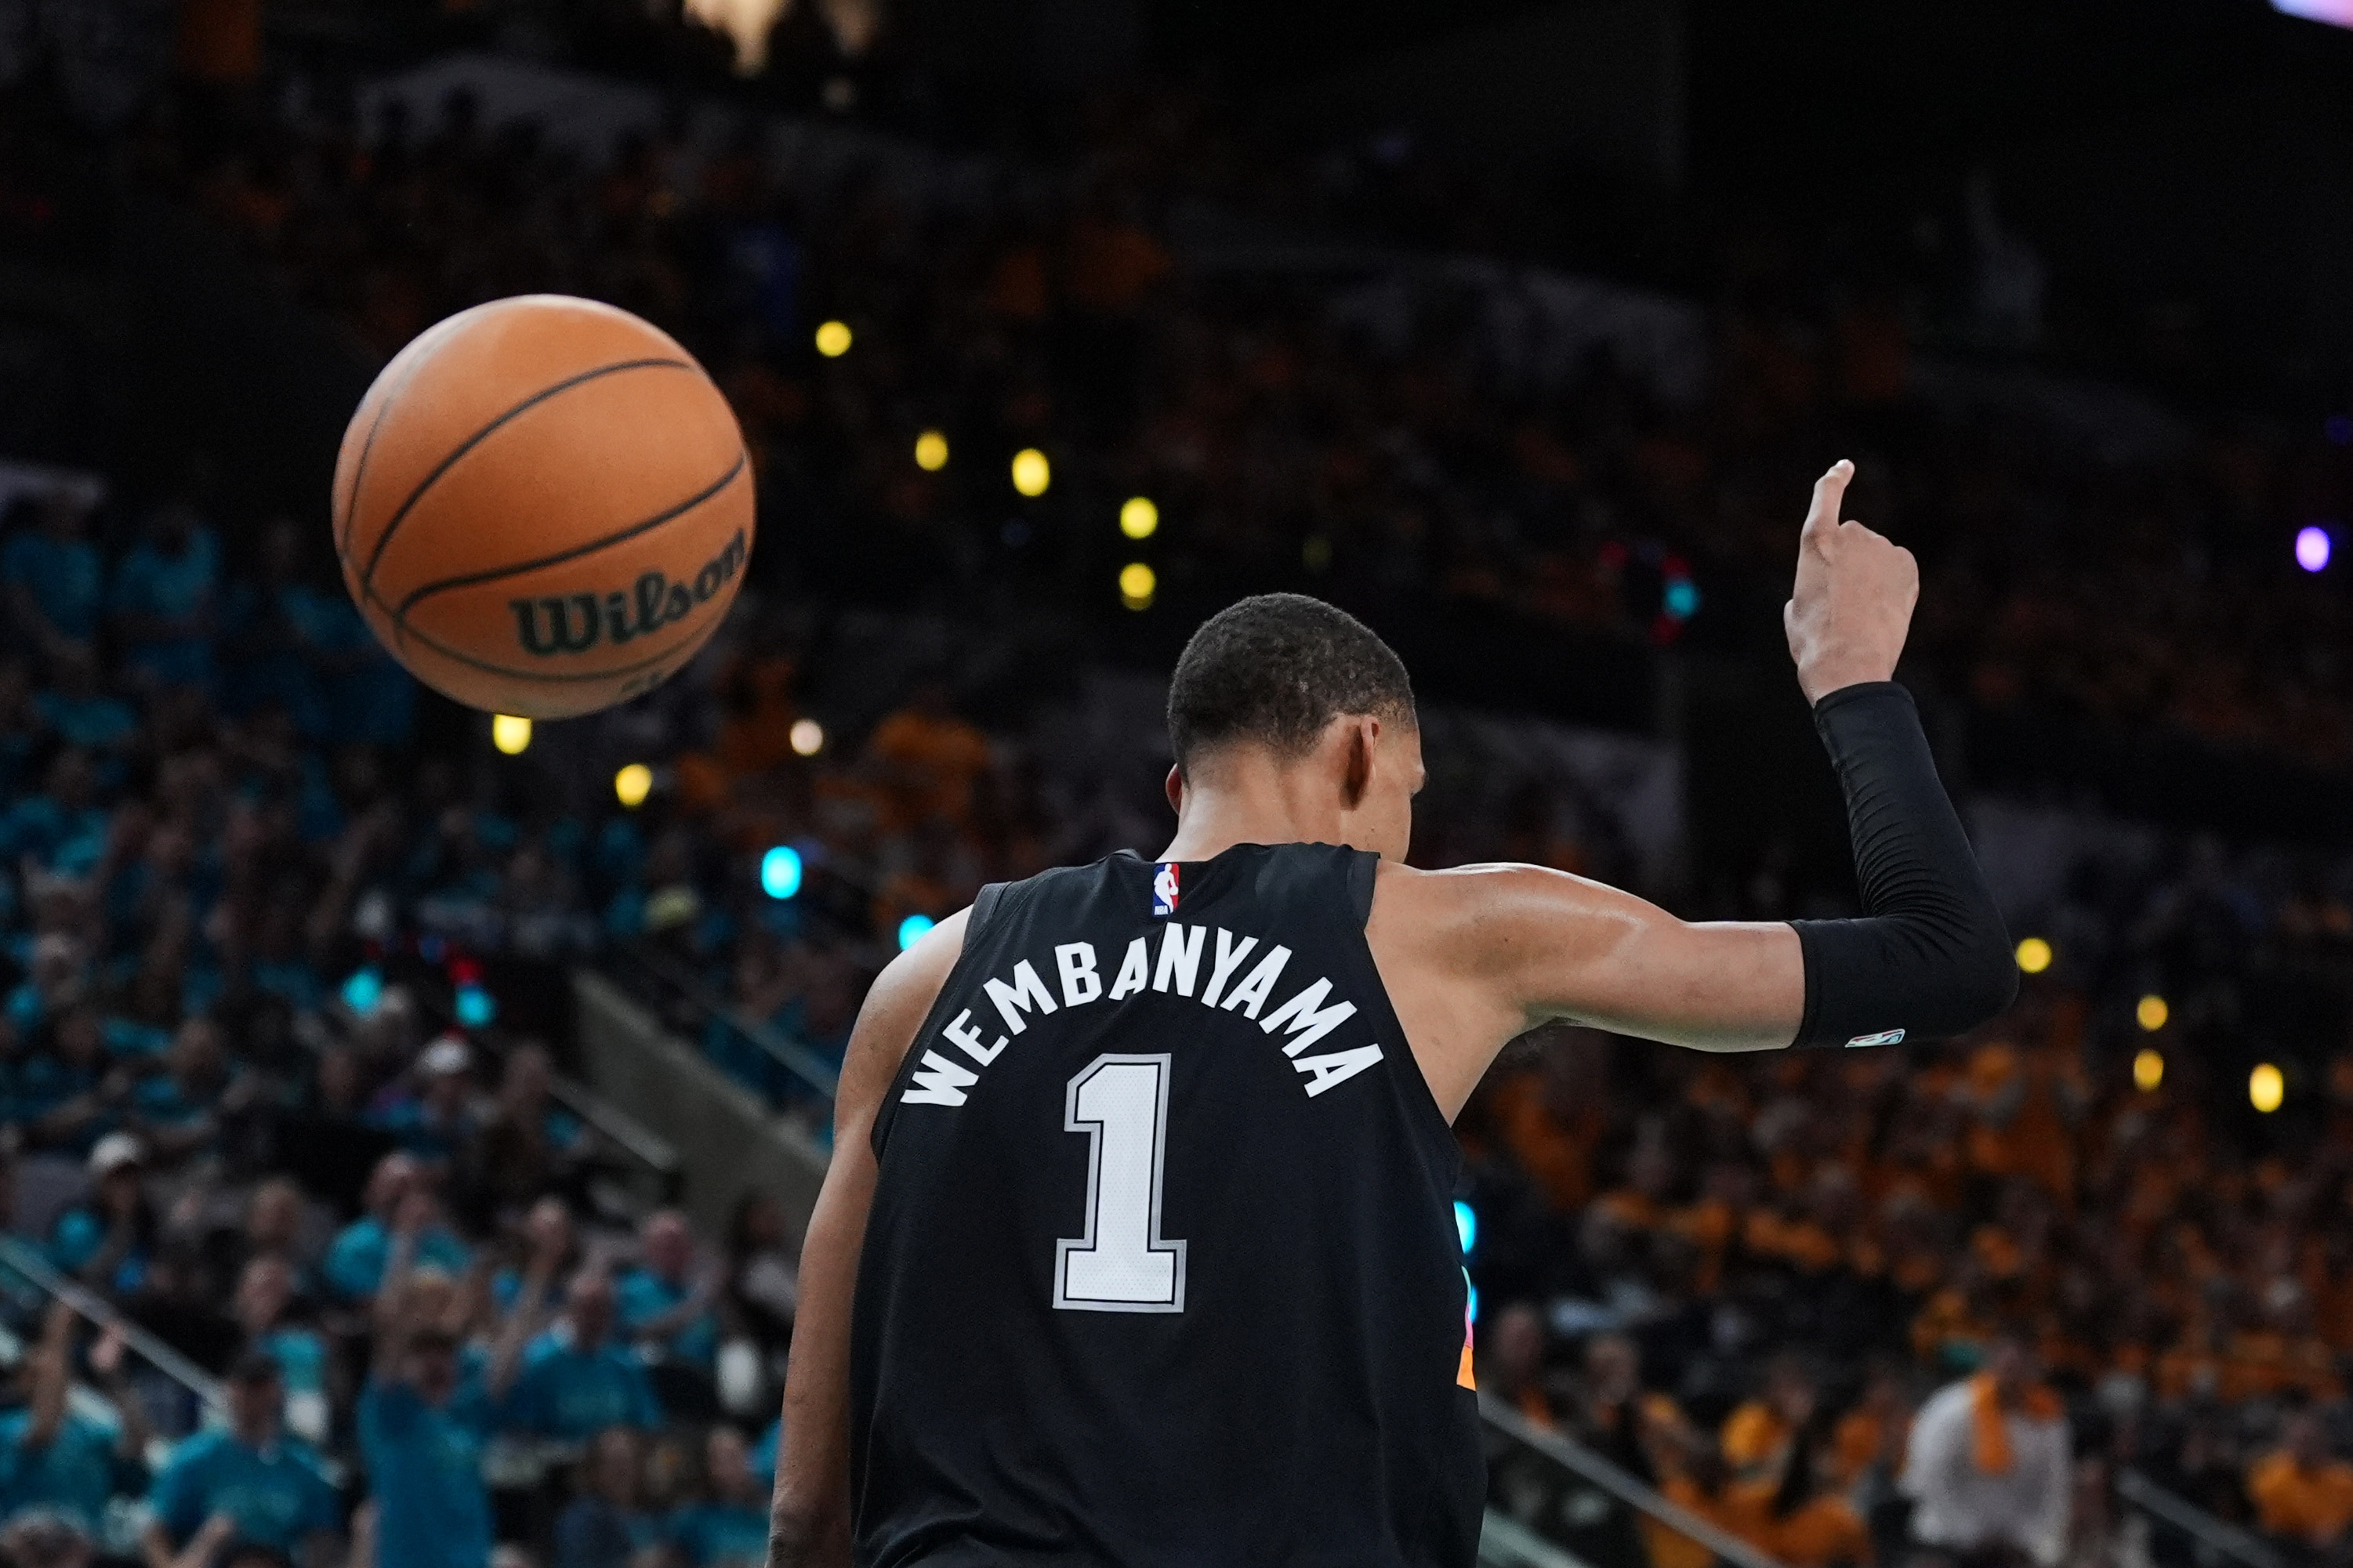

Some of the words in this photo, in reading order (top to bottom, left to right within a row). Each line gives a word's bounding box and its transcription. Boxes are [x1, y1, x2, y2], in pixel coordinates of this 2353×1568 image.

[509, 527, 745, 656] Wilson
[900, 922, 1384, 1106] WEMBANYAMA
[1053, 1053, 1187, 1313] 1
